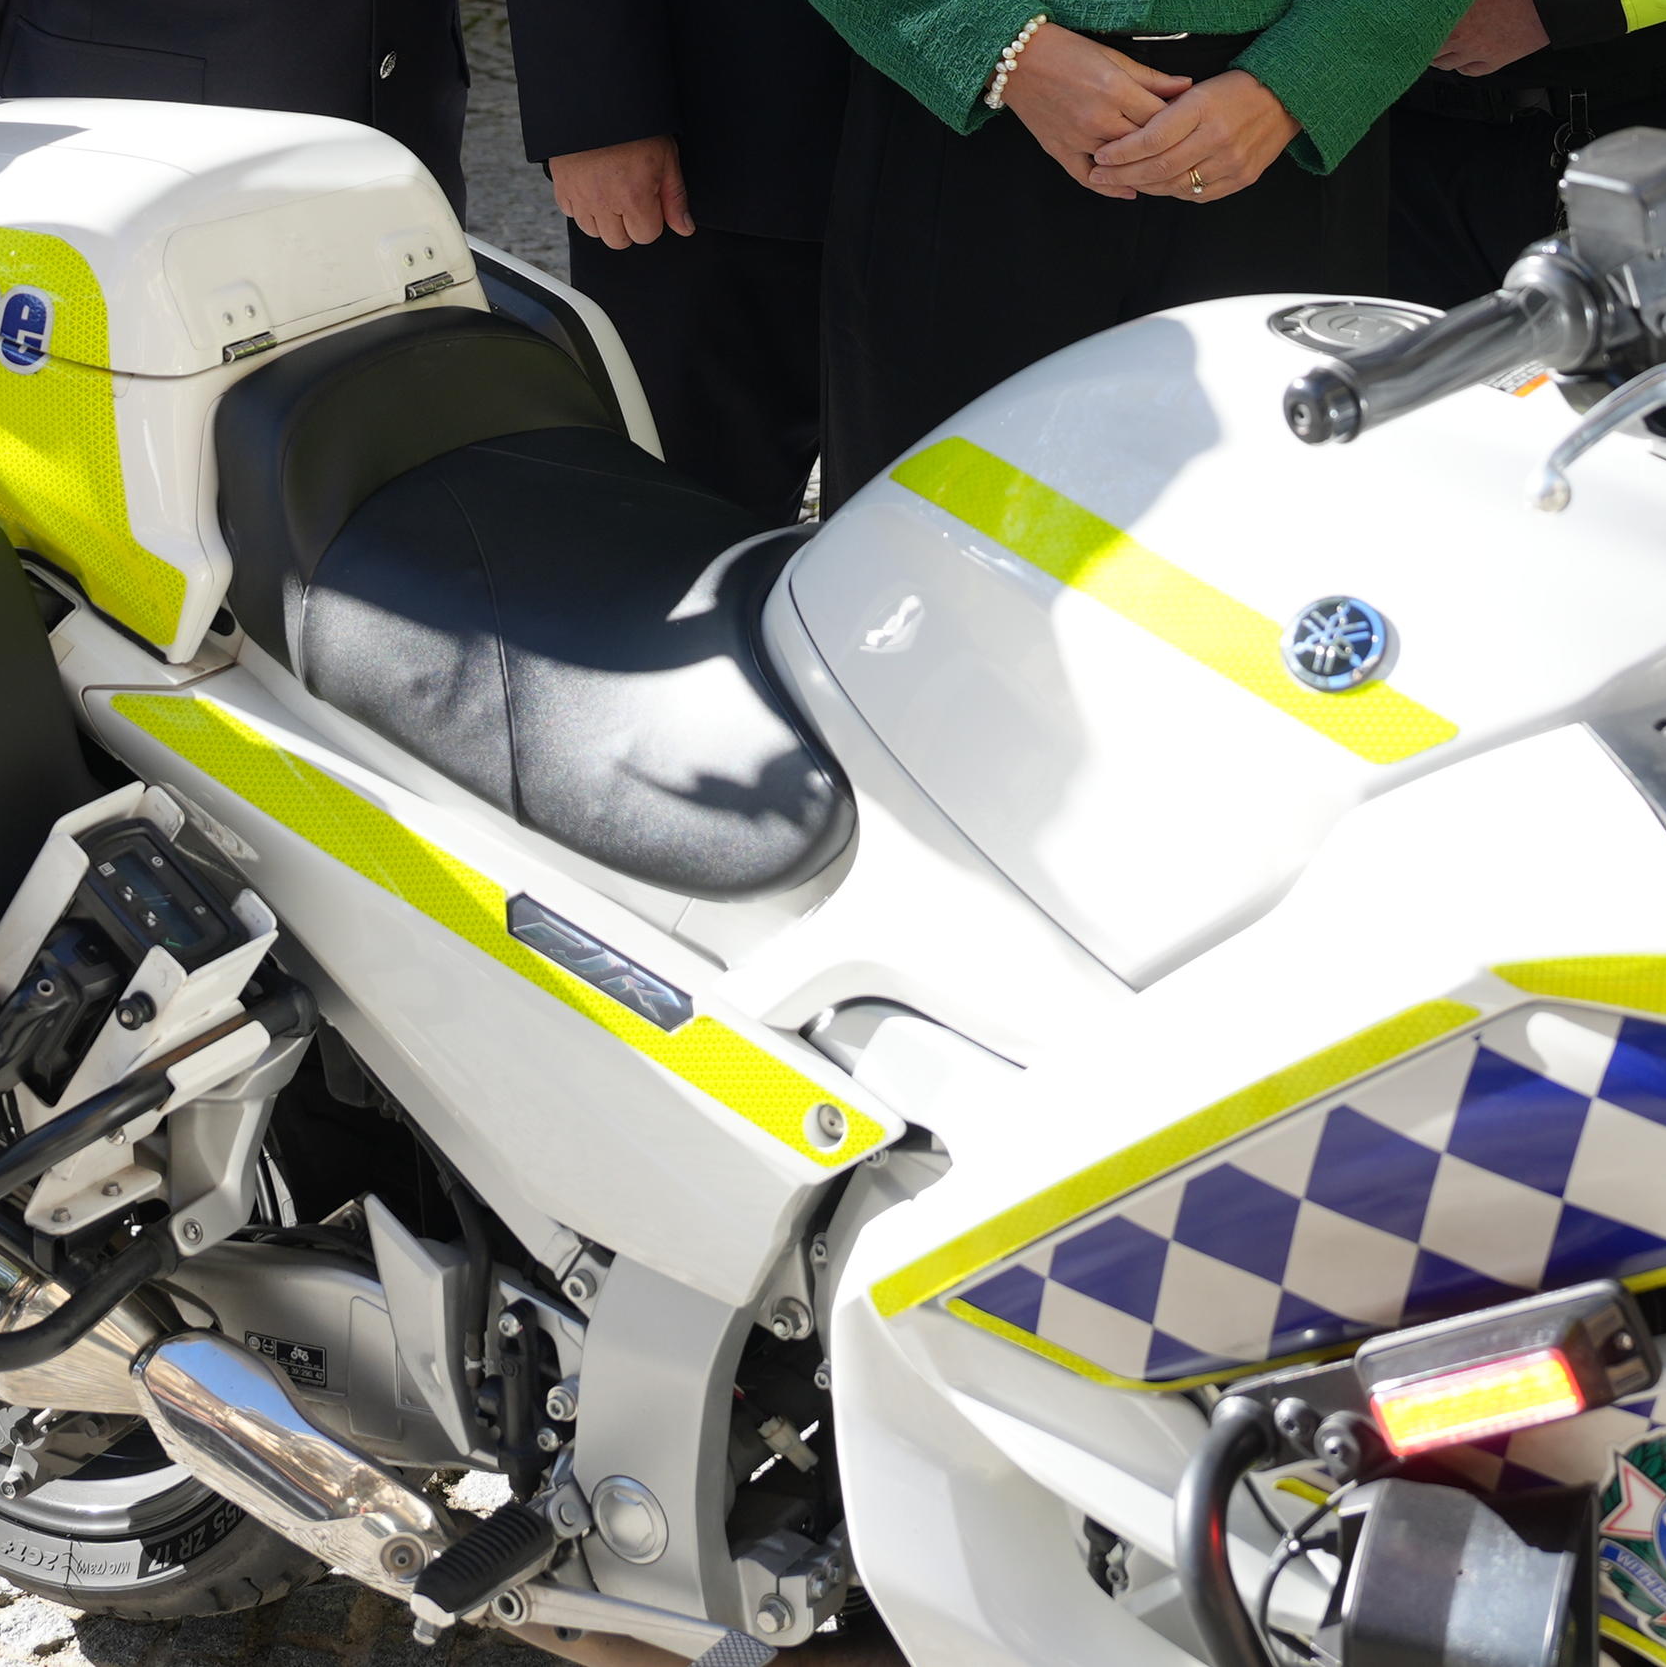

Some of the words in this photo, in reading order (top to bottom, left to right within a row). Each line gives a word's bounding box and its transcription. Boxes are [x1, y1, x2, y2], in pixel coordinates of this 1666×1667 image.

[148, 1543, 173, 1573] 17
[179, 1525, 206, 1561] ZR
[1616, 1550, 1658, 1594] WITH
